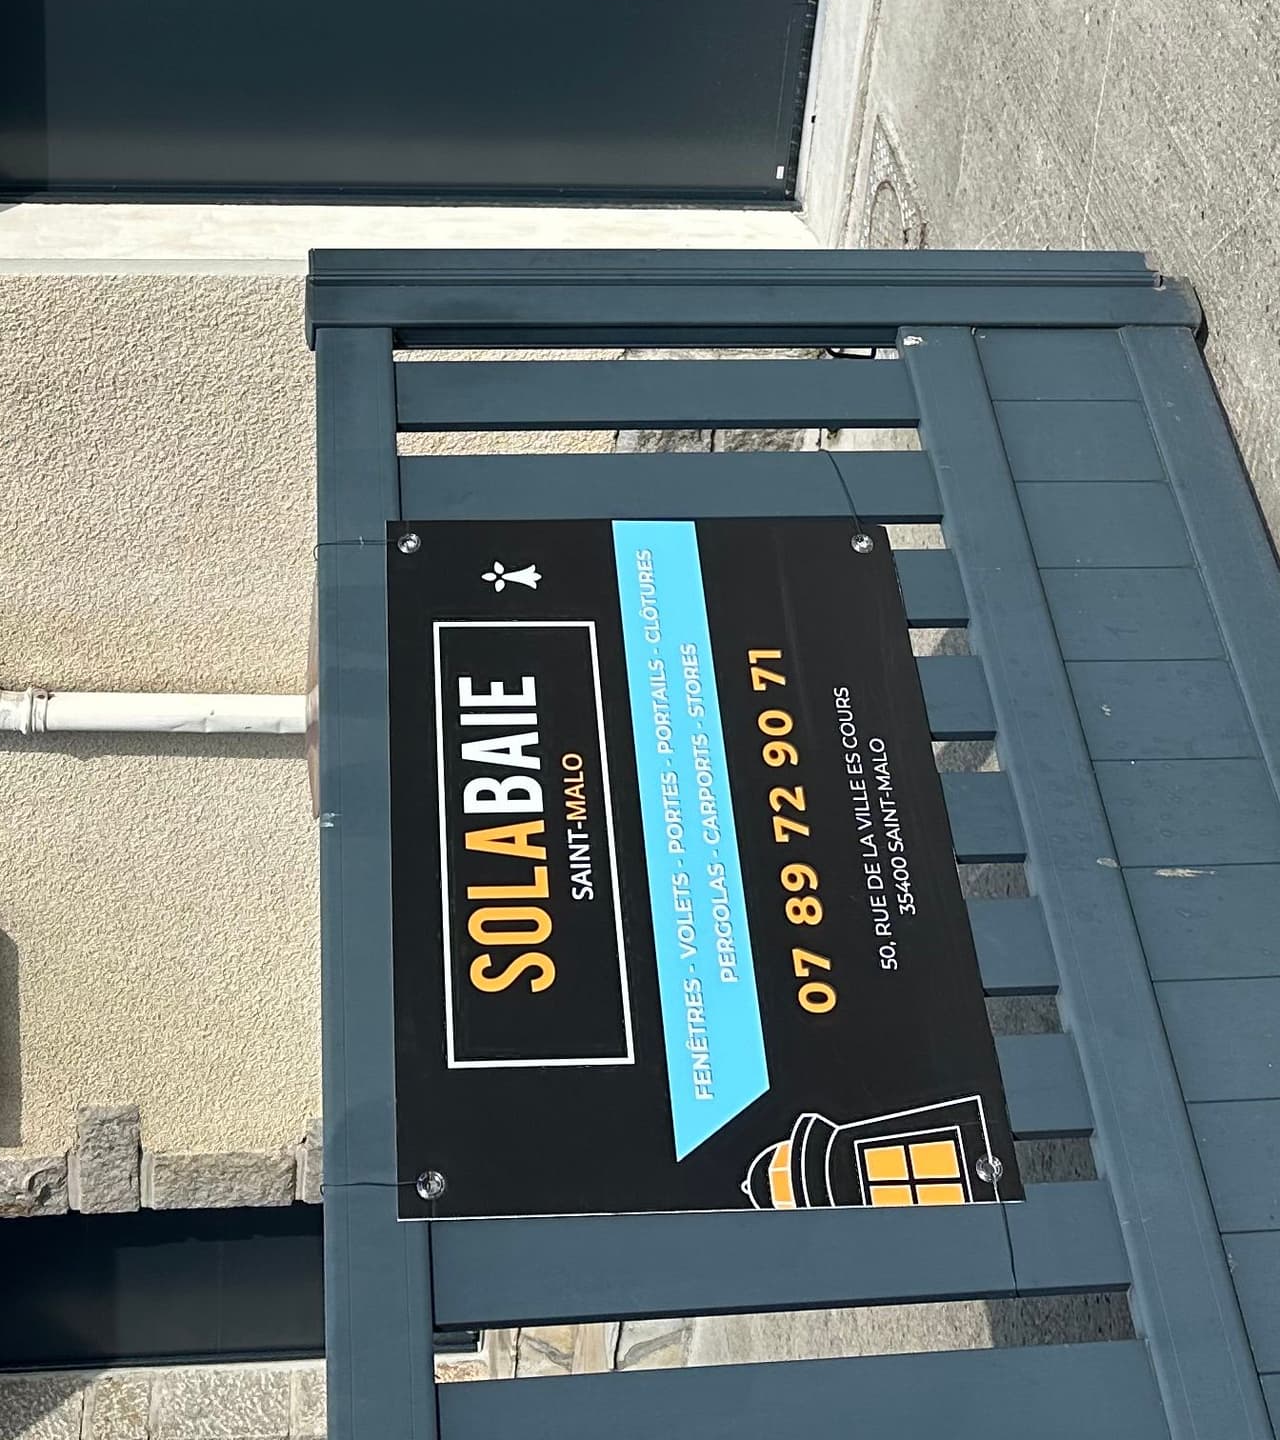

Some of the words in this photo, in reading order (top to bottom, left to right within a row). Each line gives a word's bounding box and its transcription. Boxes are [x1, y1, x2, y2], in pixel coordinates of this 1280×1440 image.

[636, 549, 661, 643] CLÔTURES
[680, 642, 705, 719] STORES
[748, 649, 785, 690] 71
[648, 658, 673, 753] PORTAILS
[834, 687, 858, 749] COURS
[758, 710, 798, 767] 90
[846, 753, 862, 774] ES
[661, 771, 685, 853] PORTES
[691, 732, 721, 844] CARPORTS
[769, 786, 809, 842] 72
[850, 780, 872, 832] VILLE
[867, 737, 904, 851] SAINT-MALO
[459, 677, 555, 992] SOLABAIE
[561, 753, 594, 901] SAINT-MALO
[860, 831, 877, 857] LA
[781, 864, 822, 925] 89
[865, 862, 883, 889] DE
[890, 857, 915, 916] 35400
[673, 873, 697, 959] VOLETS
[707, 862, 739, 982] PERGOLAS
[871, 895, 892, 935] RUE
[792, 948, 836, 1013] 07
[879, 942, 898, 970] 50,
[685, 979, 714, 1099] FENÊTRES
